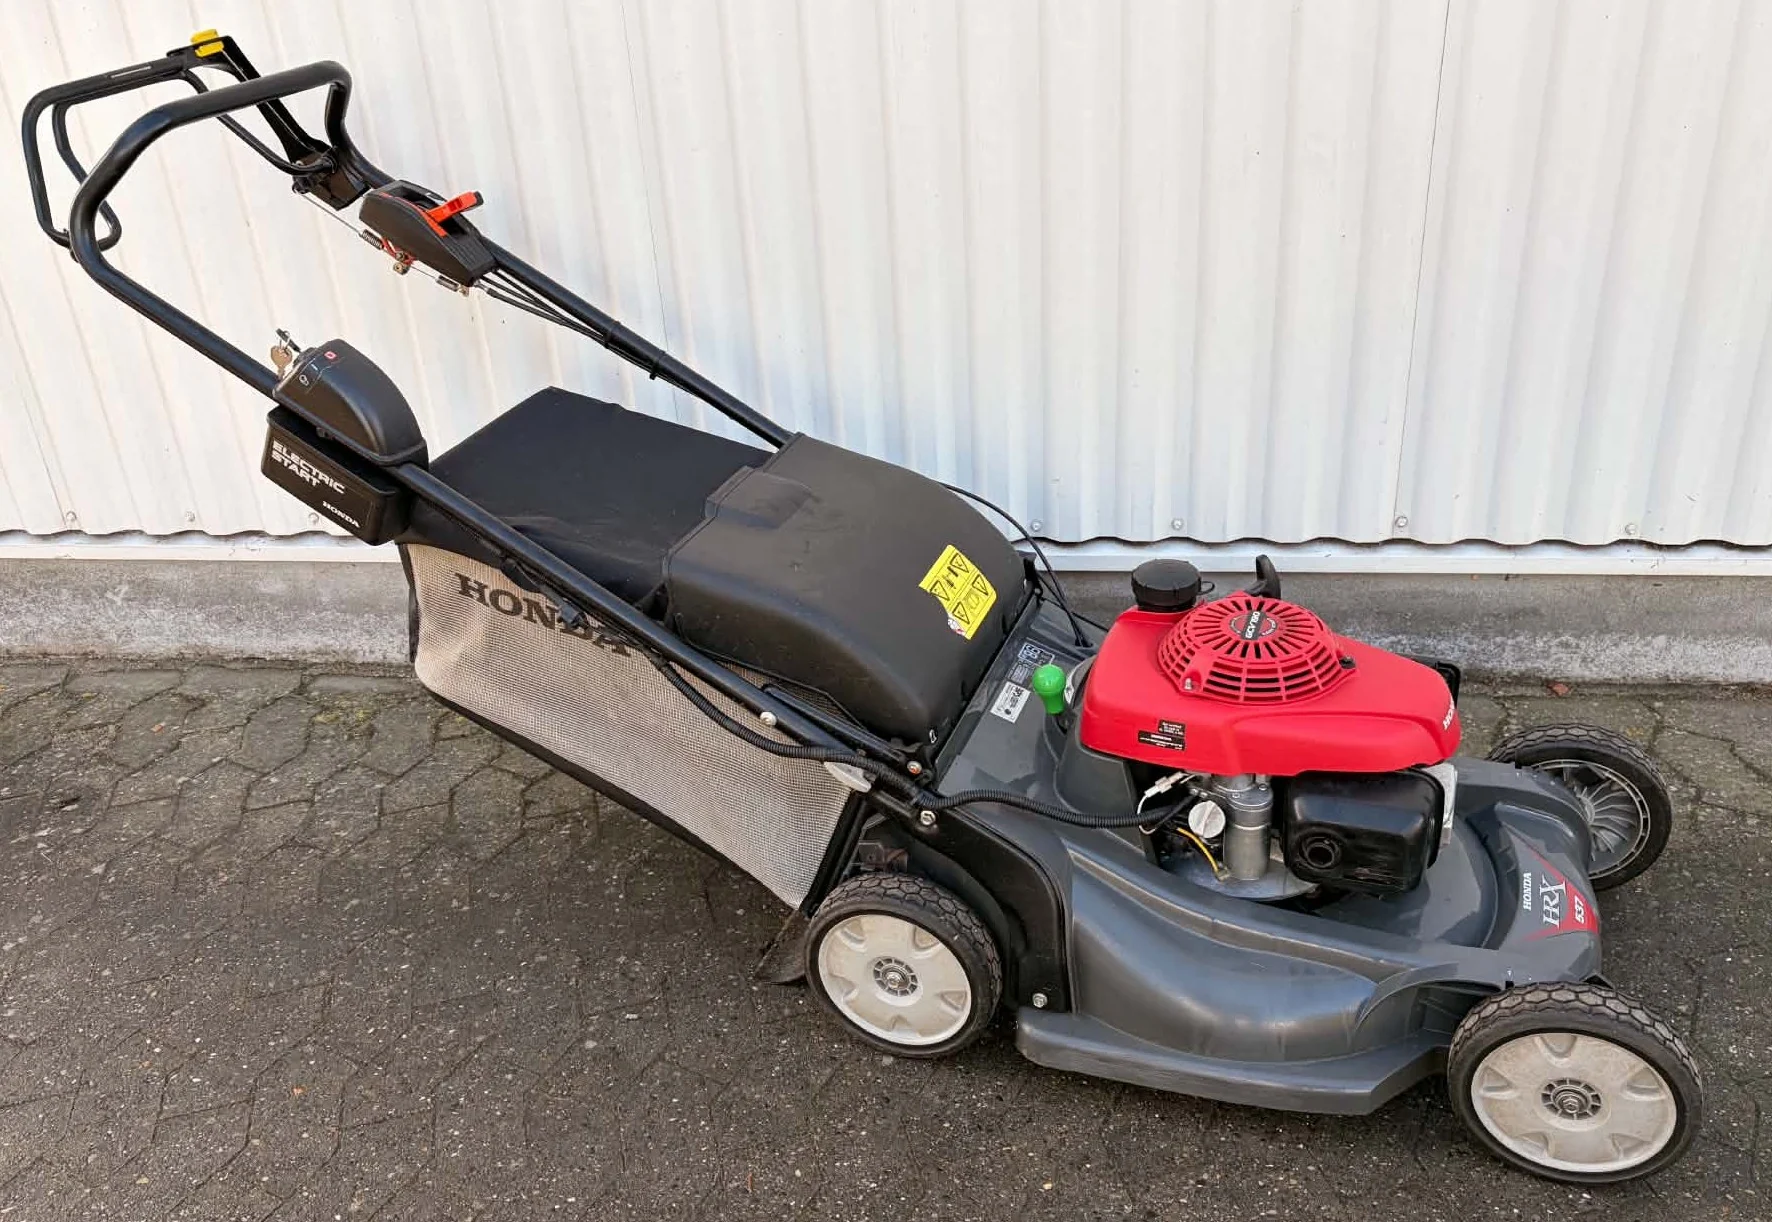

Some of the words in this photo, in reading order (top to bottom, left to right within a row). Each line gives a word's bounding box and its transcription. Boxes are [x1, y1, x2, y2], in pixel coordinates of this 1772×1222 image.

[271, 450, 321, 487] START
[272, 440, 346, 494] ELECTRIC
[322, 501, 360, 528] HONDA
[1522, 872, 1532, 912] HONDA
[1540, 873, 1567, 930] HRX
[1574, 895, 1586, 925] 537
